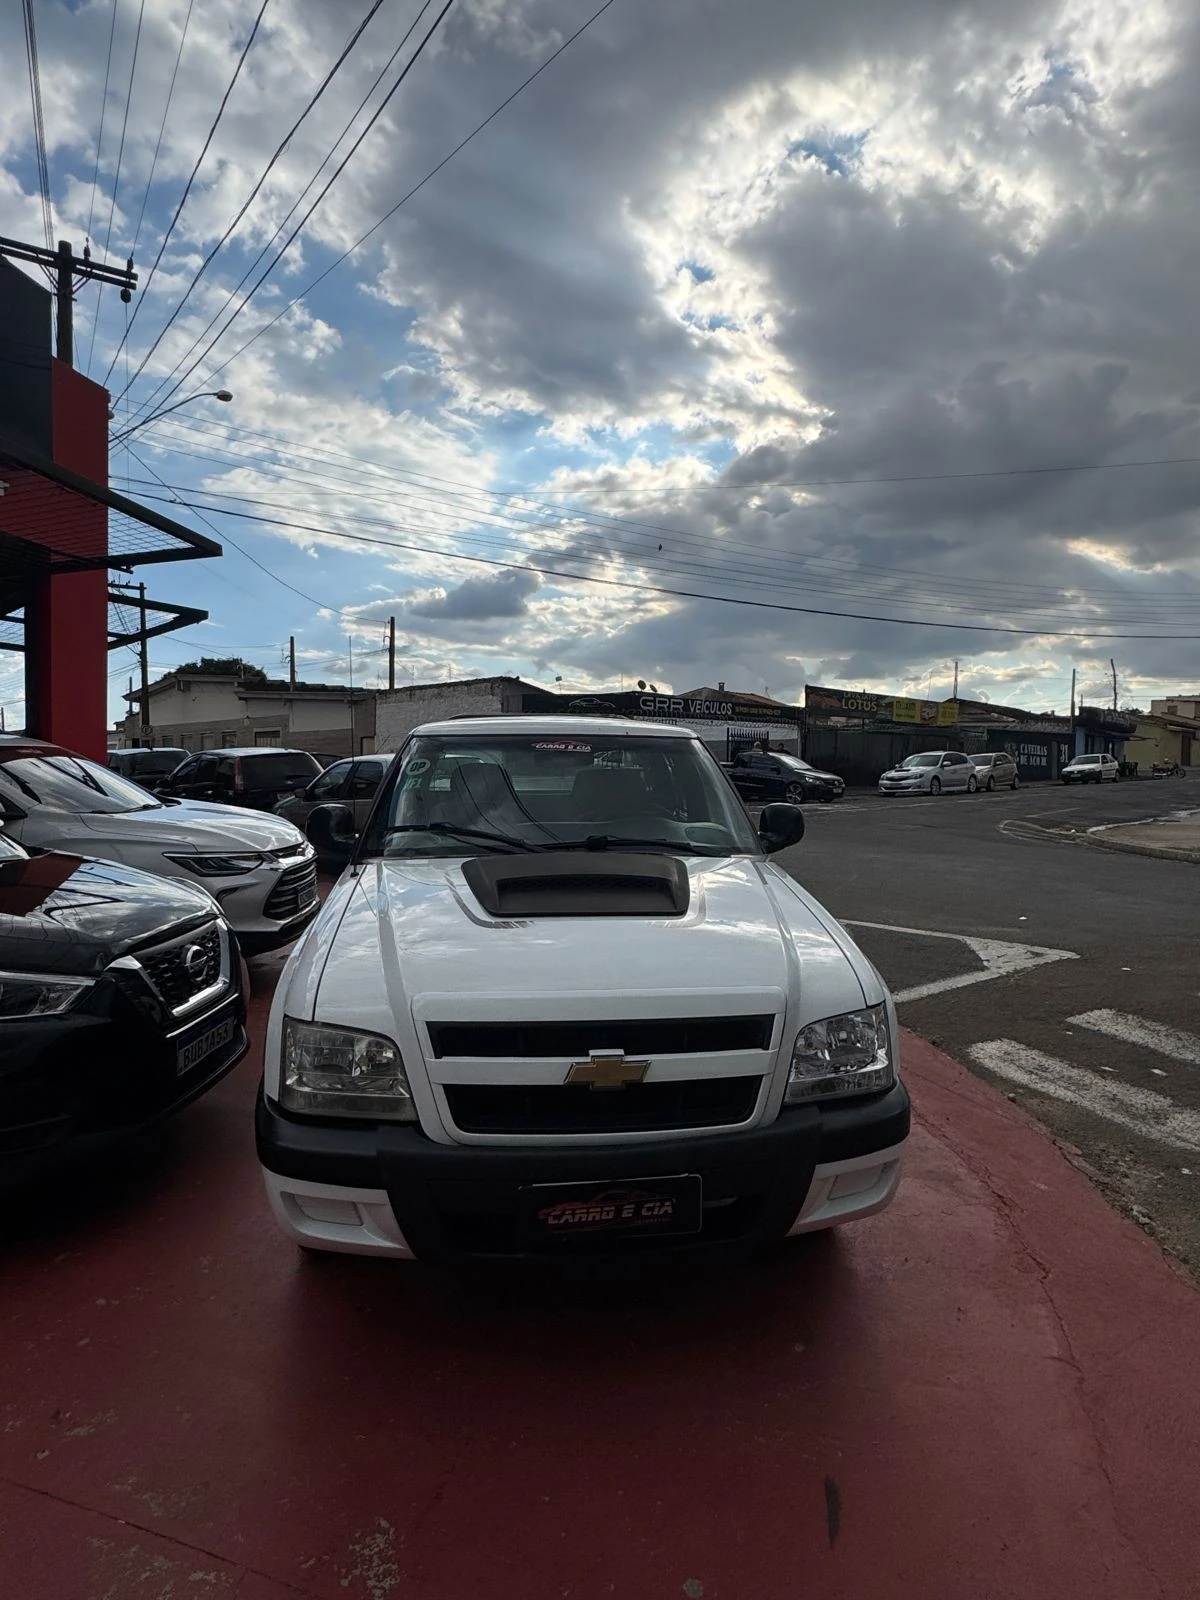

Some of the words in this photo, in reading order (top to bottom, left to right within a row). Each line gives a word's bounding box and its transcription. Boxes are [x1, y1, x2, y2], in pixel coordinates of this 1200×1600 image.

[639, 697, 685, 712] GRR
[688, 699, 733, 715] VEÍCULOS
[842, 699, 877, 712] LOTUS
[1020, 743, 1048, 756] CAVEIRAS
[1060, 743, 1069, 763] 31
[1020, 755, 1028, 765] DE
[548, 1206, 616, 1225] CARRO
[621, 1204, 635, 1218] E
[641, 1201, 673, 1216] CIA
